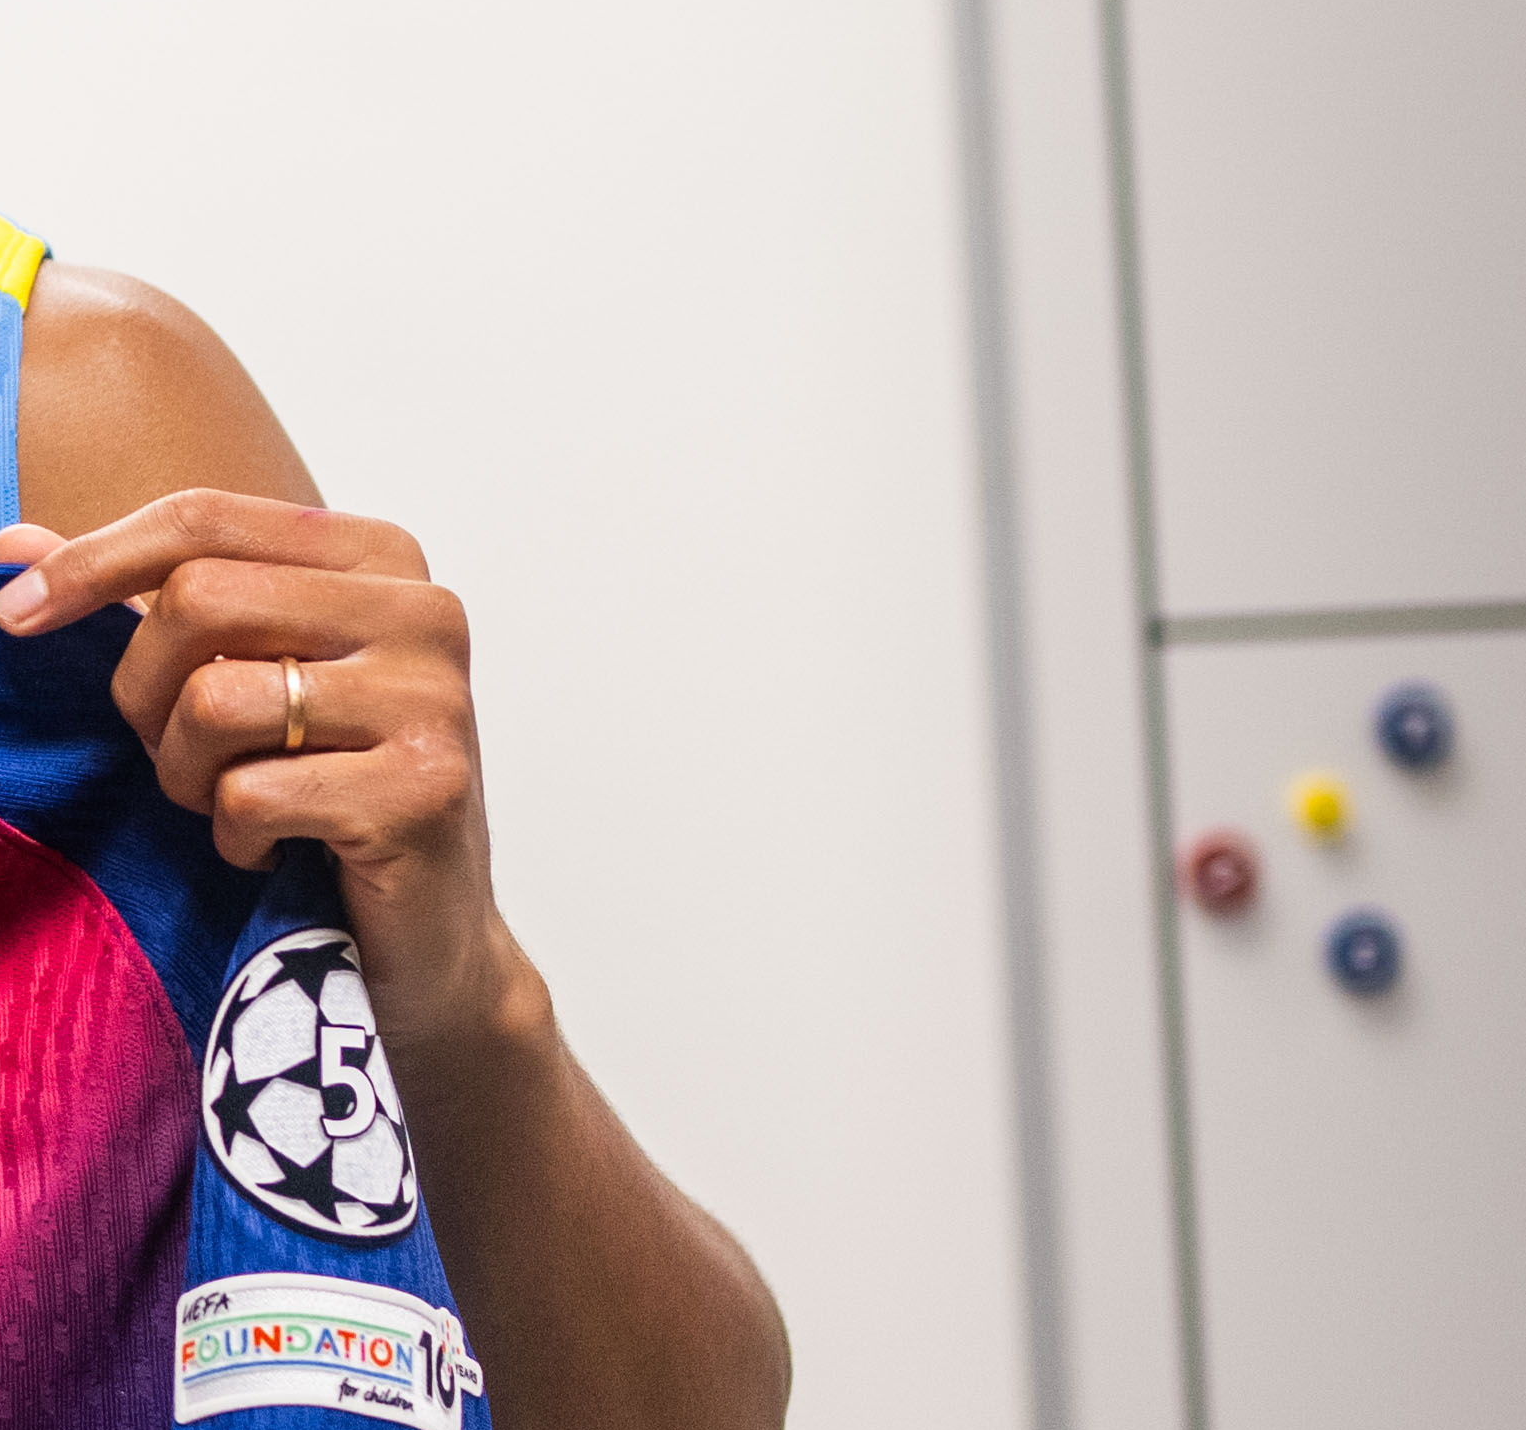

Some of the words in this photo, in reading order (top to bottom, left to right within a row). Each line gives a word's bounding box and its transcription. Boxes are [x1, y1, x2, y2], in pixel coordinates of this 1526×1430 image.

[319, 1025, 377, 1139] 5
[181, 1291, 231, 1324] UEFA
[338, 1376, 360, 1402] for
[363, 1384, 415, 1412] children
